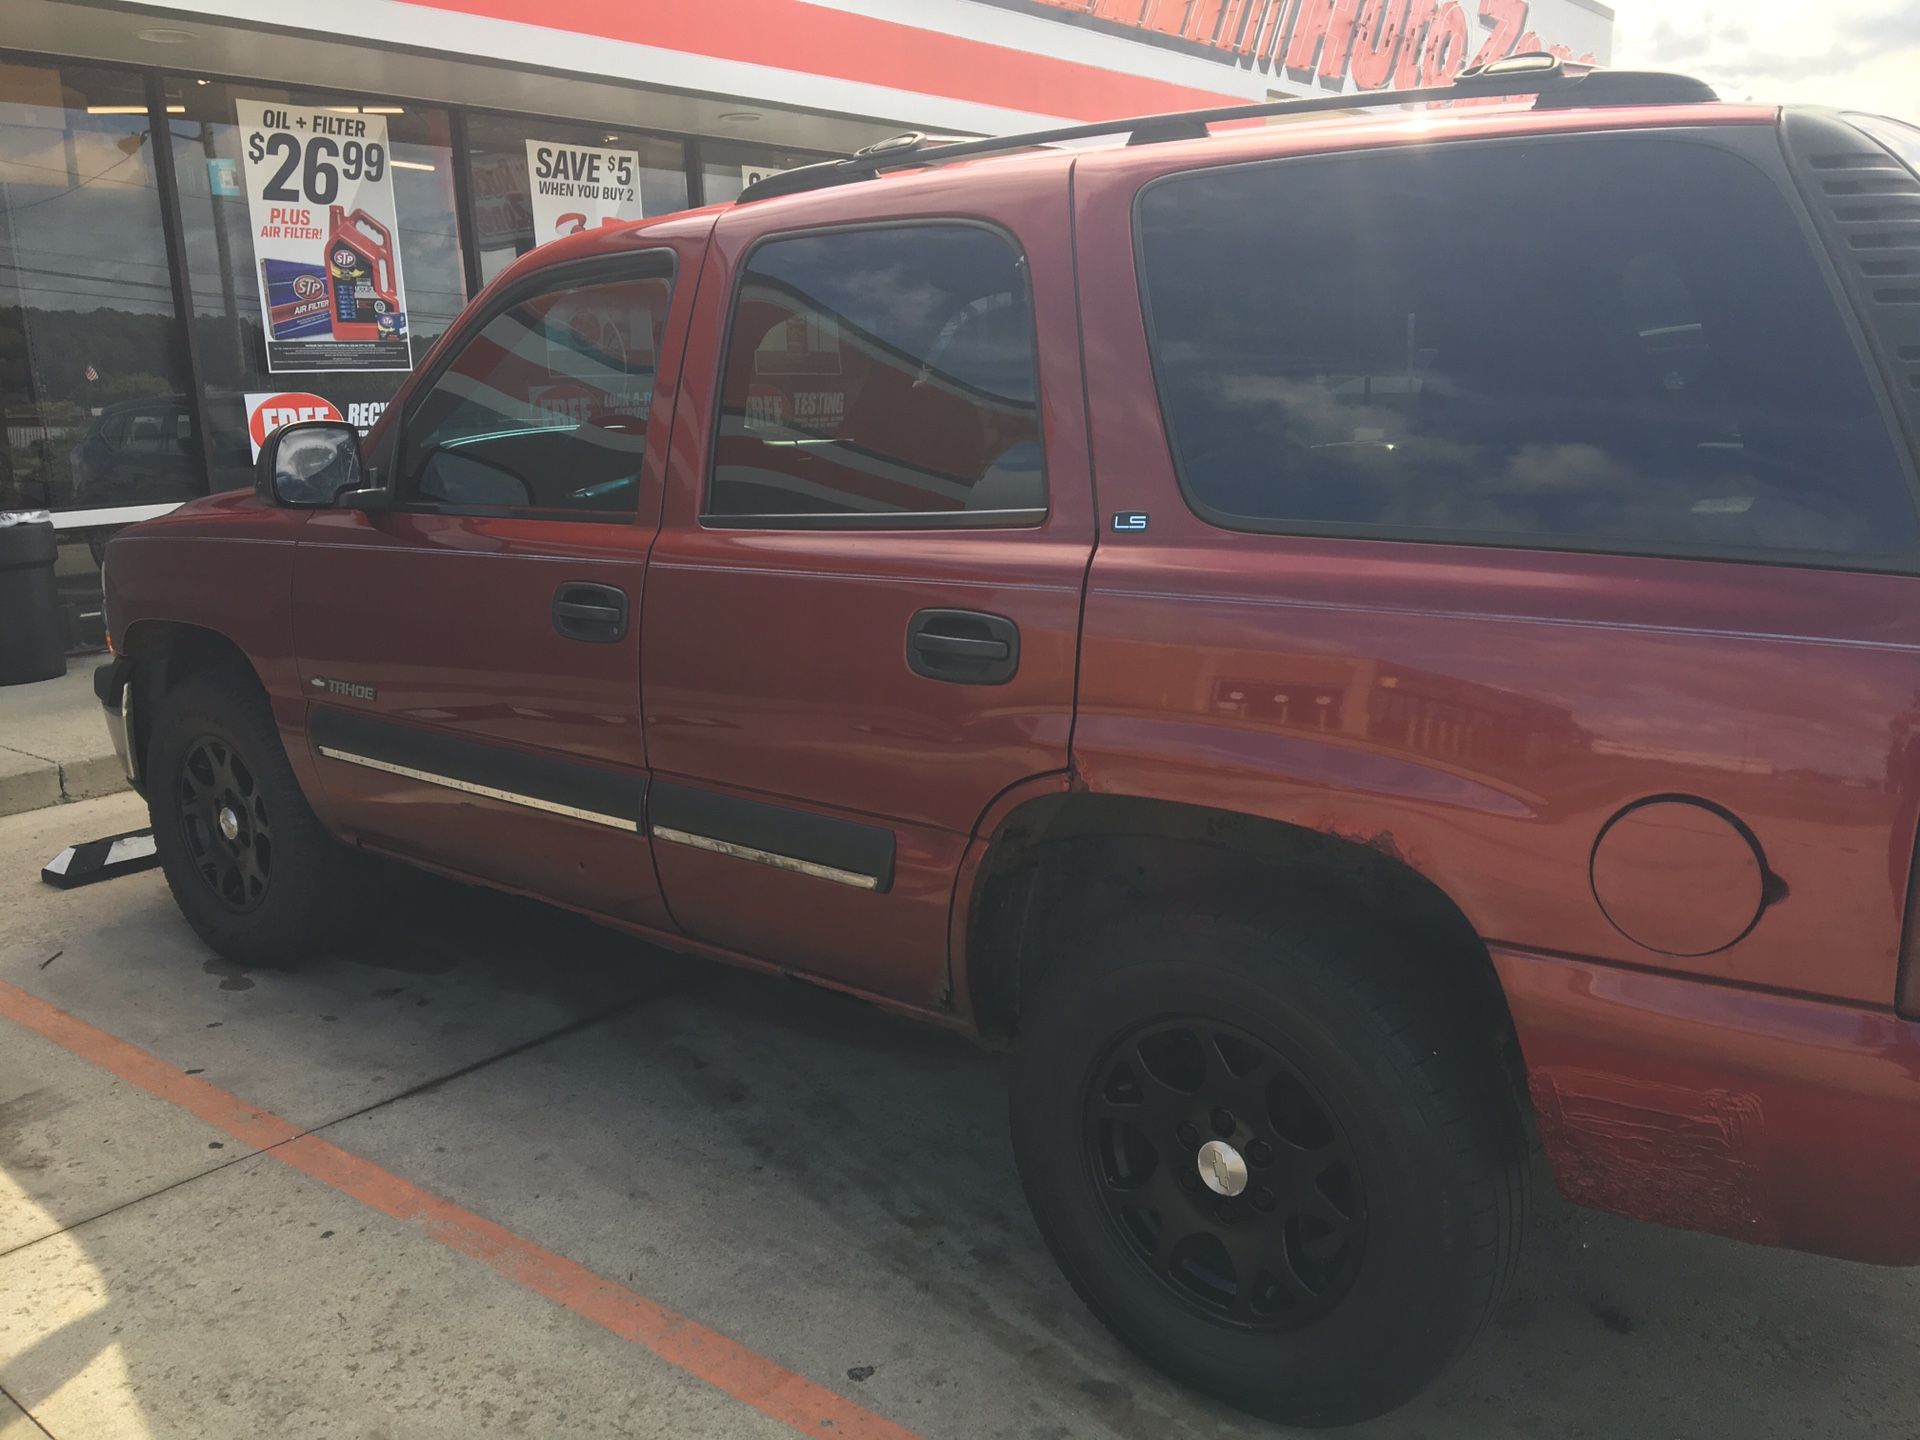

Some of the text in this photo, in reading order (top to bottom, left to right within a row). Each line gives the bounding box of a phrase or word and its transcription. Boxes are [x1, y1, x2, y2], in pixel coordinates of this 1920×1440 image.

[263, 109, 290, 130] OIL
[312, 115, 366, 138] FILTER
[536, 147, 632, 186] SAVE $5
[538, 181, 634, 202] WHEN YOU BUY 2
[270, 208, 311, 226] PLUS
[260, 226, 323, 240] AIR FILTER!
[336, 252, 354, 265] STP
[295, 279, 322, 301] STP
[294, 299, 330, 315] AIR FILTER
[1115, 516, 1146, 528] LS
[328, 680, 374, 700] TAHOE
